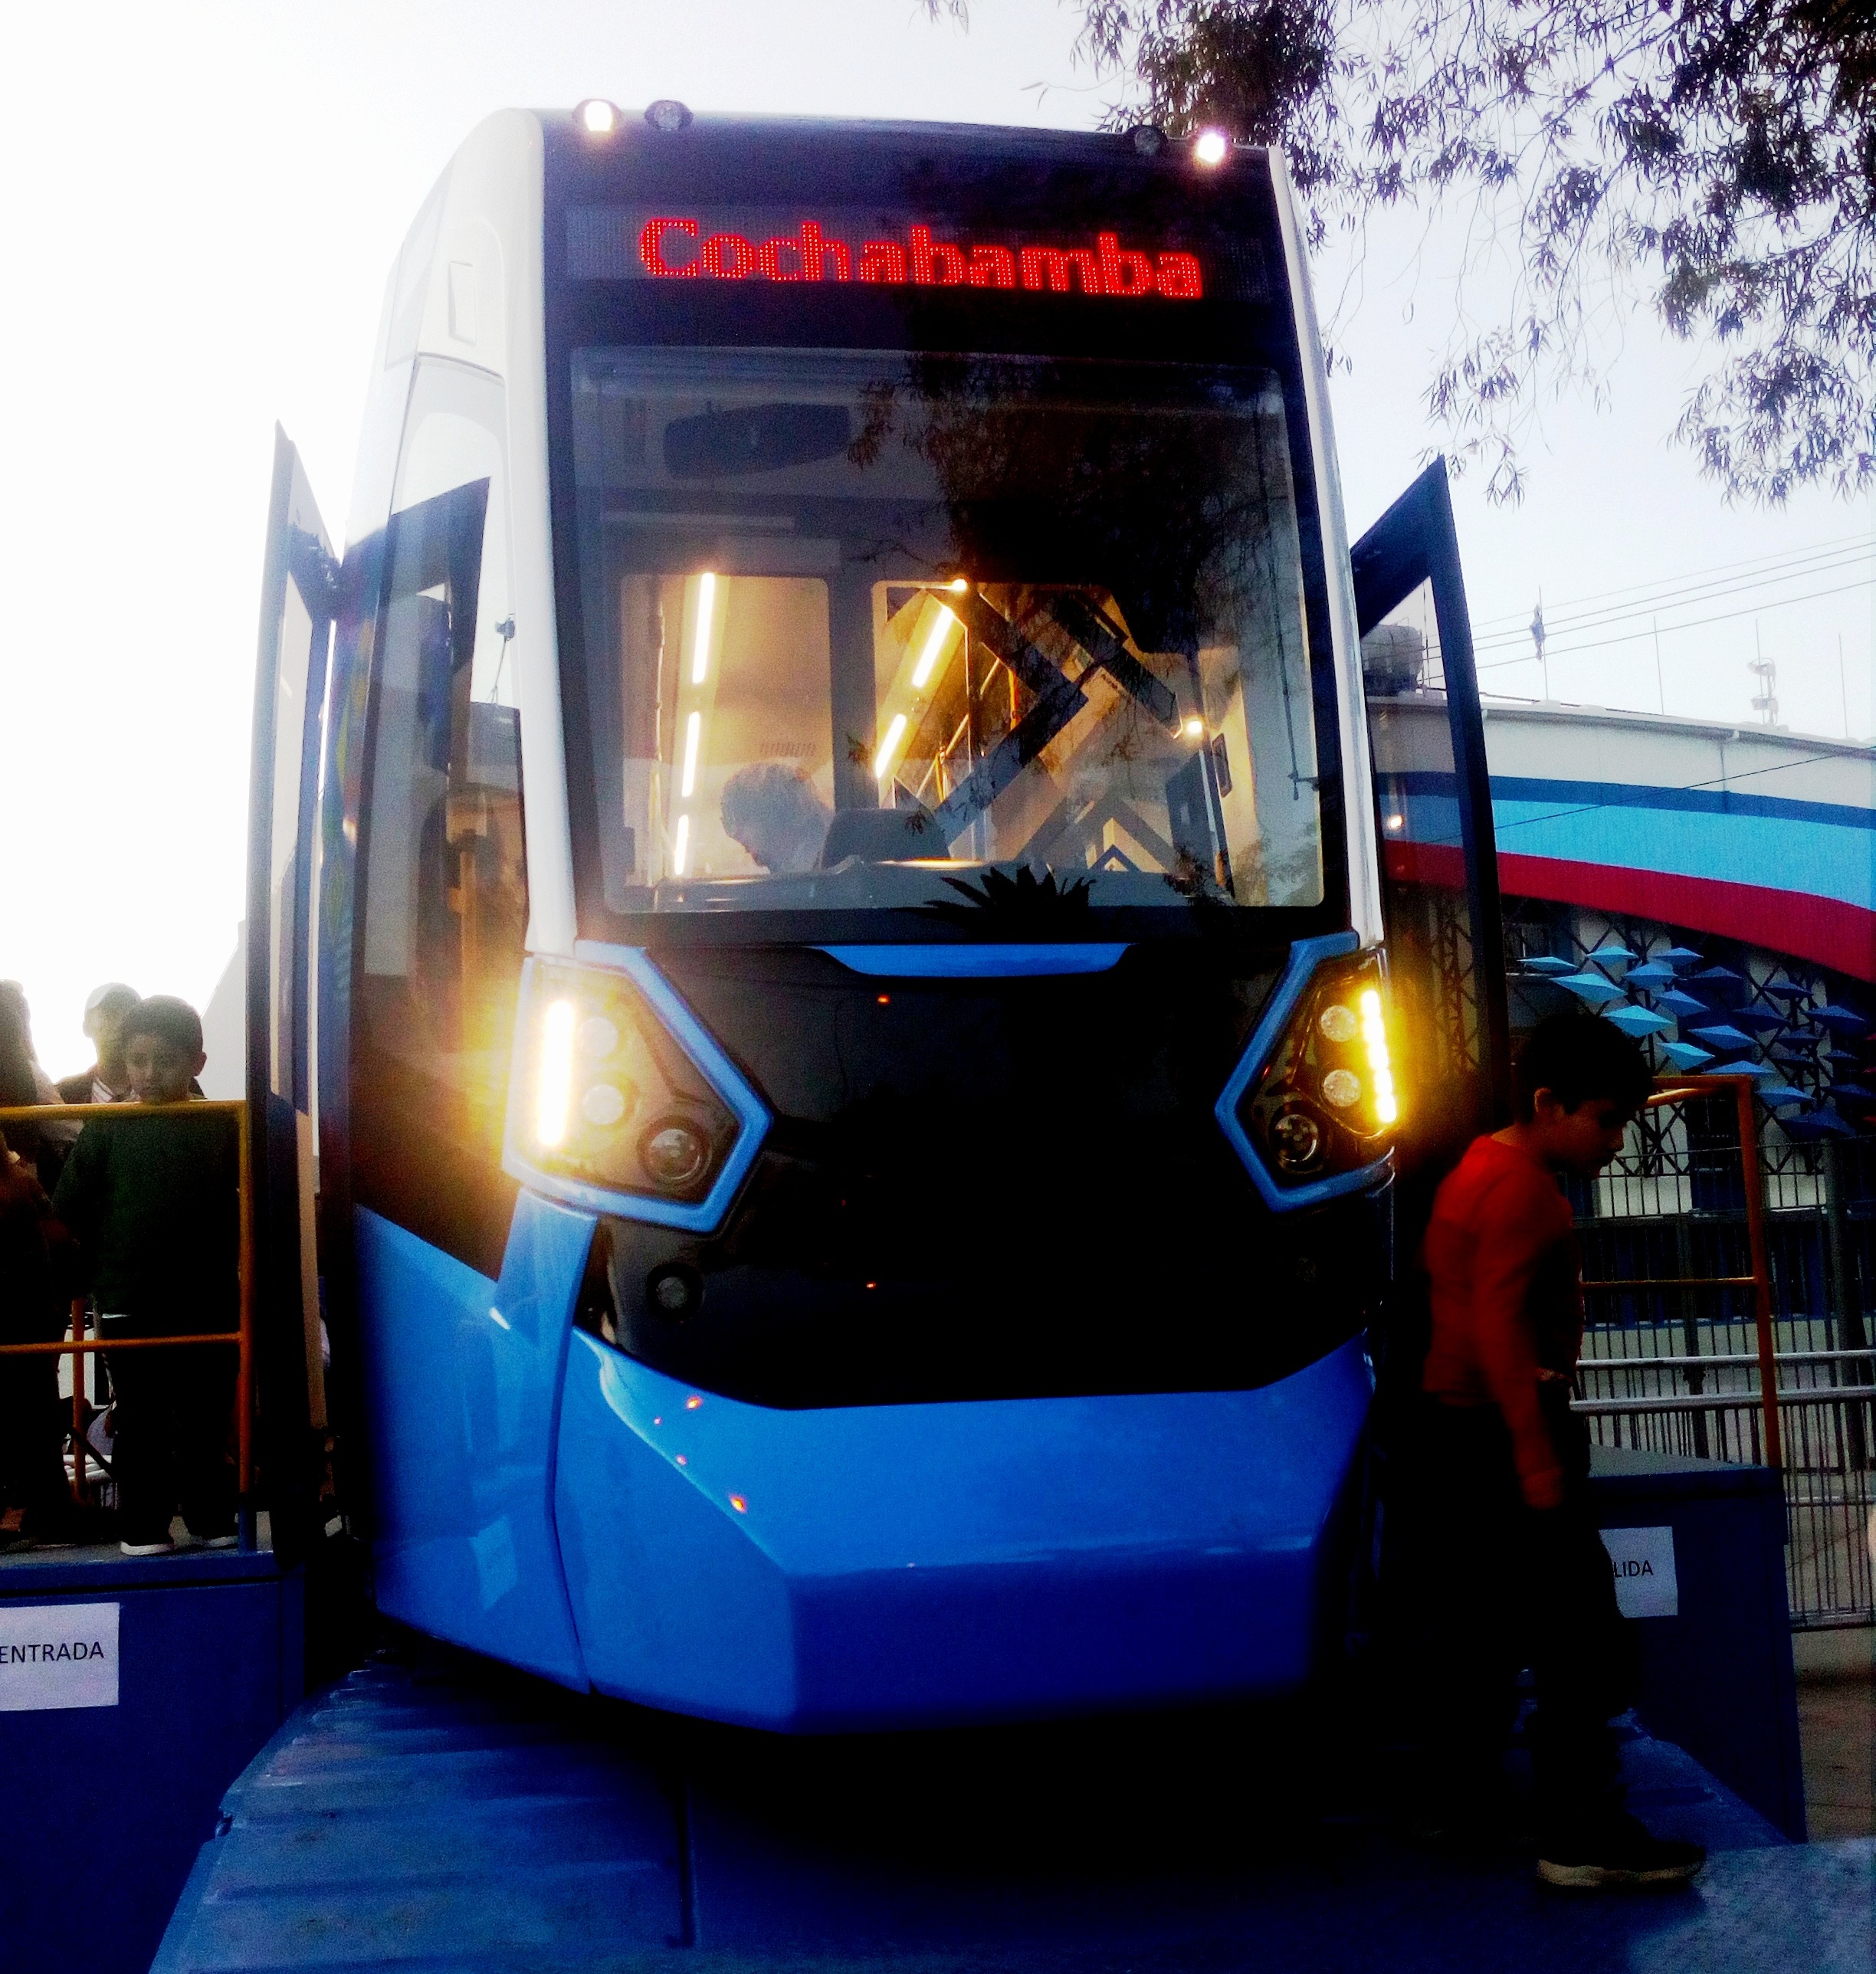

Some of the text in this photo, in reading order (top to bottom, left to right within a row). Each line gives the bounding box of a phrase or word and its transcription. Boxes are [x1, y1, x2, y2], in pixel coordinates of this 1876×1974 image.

[638, 217, 1203, 299] Cochabamba
[1612, 1559, 1654, 1578] LIDA
[0, 1641, 105, 1664] ENTRADA
